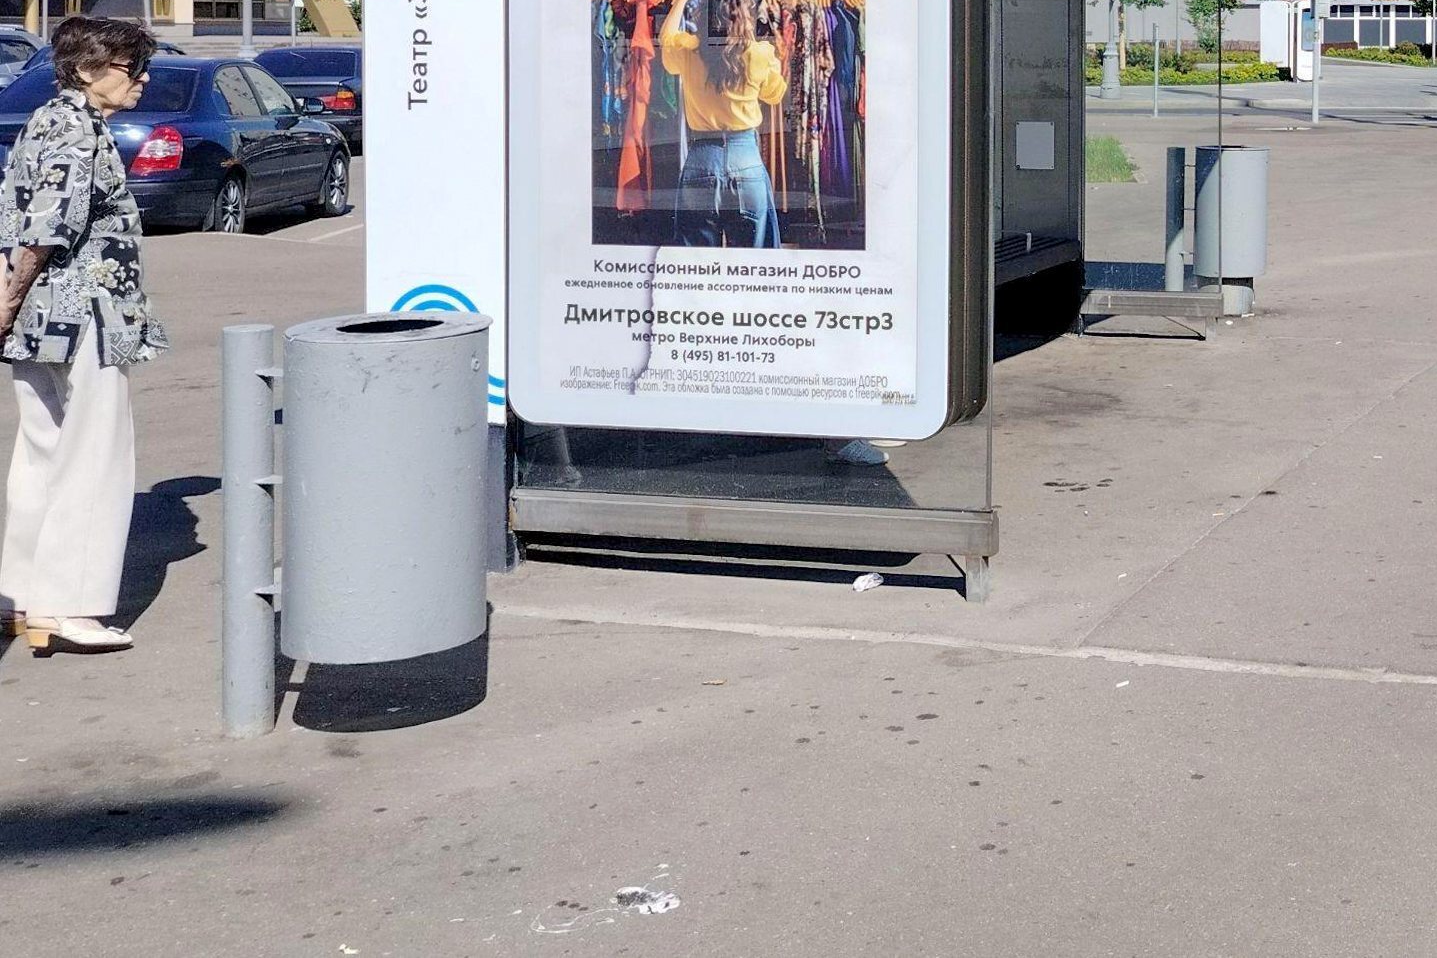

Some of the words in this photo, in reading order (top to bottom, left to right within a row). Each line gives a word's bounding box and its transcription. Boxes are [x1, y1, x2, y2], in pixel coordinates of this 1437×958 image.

[408, 28, 432, 110] Театр
[594, 259, 721, 276] Комиссионный
[727, 265, 798, 278] магазин
[802, 265, 861, 280] ДОБРО
[565, 279, 633, 289] ежедневное
[636, 278, 704, 291] обновление
[707, 281, 788, 294] ассортимента
[791, 285, 805, 293] по
[808, 286, 851, 294] низким
[855, 286, 893, 296] ценам
[564, 303, 724, 328] Дмитровское
[732, 312, 807, 328] шоссе
[814, 310, 893, 334] 73стр3
[632, 332, 675, 347] метро
[679, 333, 738, 347] Верхние
[742, 334, 815, 349] Лихоборы
[671, 350, 679, 360] 8
[683, 350, 713, 364] (495)
[718, 351, 775, 363] 81-101-73
[569, 366, 581, 377] ИП
[583, 366, 620, 379] Астафьев
[759, 373, 820, 386] комиссионный
[822, 376, 857, 387] магазин
[859, 375, 888, 389] ДОБРО
[663, 381, 675, 392] Эта
[677, 382, 709, 394] обложка
[732, 385, 763, 396] создана
[772, 387, 809, 398] помощью
[811, 389, 848, 400] ресурсов
